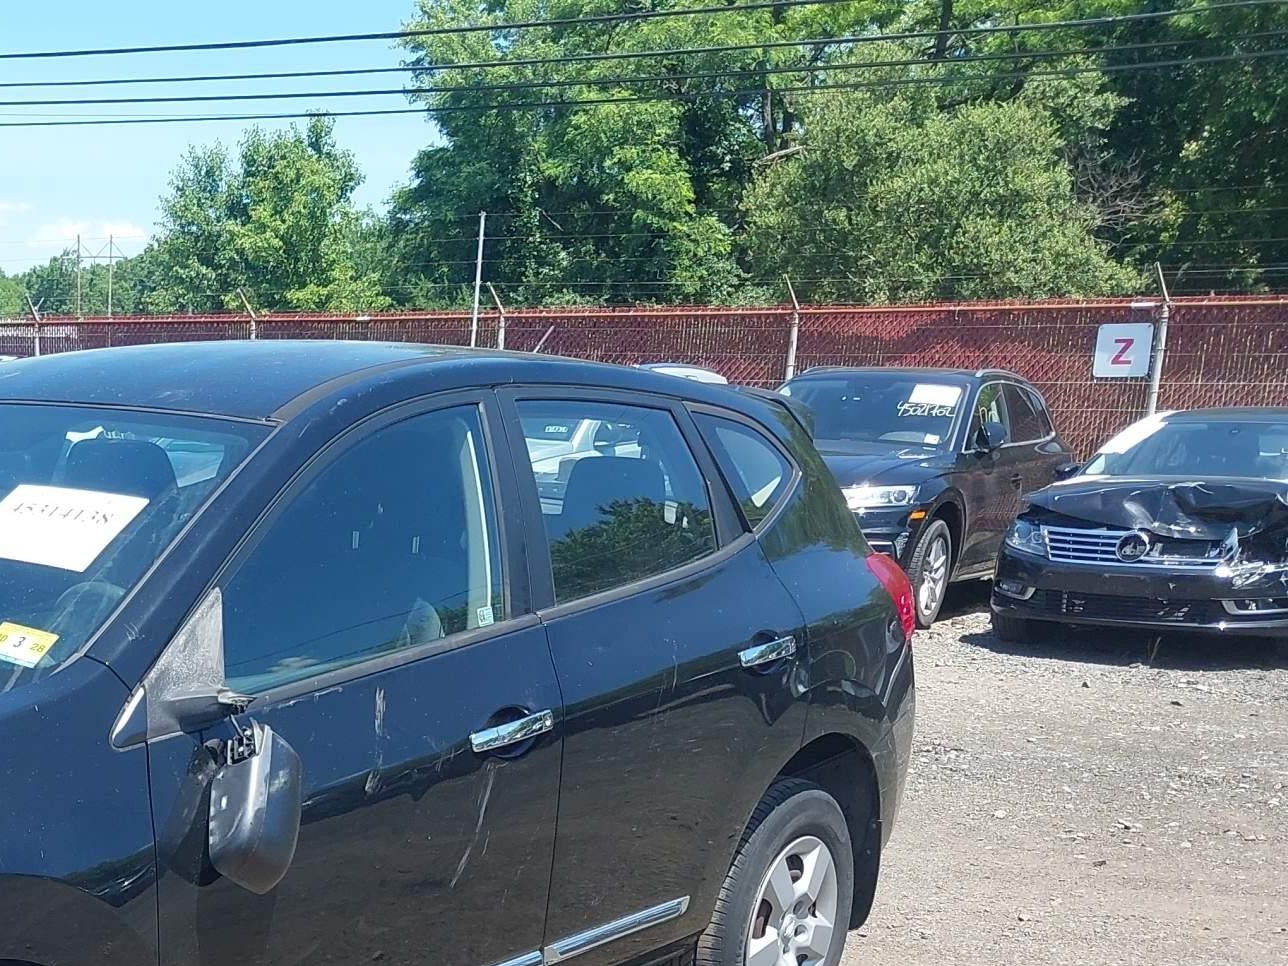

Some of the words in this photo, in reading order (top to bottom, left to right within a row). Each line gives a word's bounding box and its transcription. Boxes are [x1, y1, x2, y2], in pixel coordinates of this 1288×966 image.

[1111, 338, 1135, 365] Z
[13, 636, 26, 648] 3
[30, 642, 46, 653] 28
